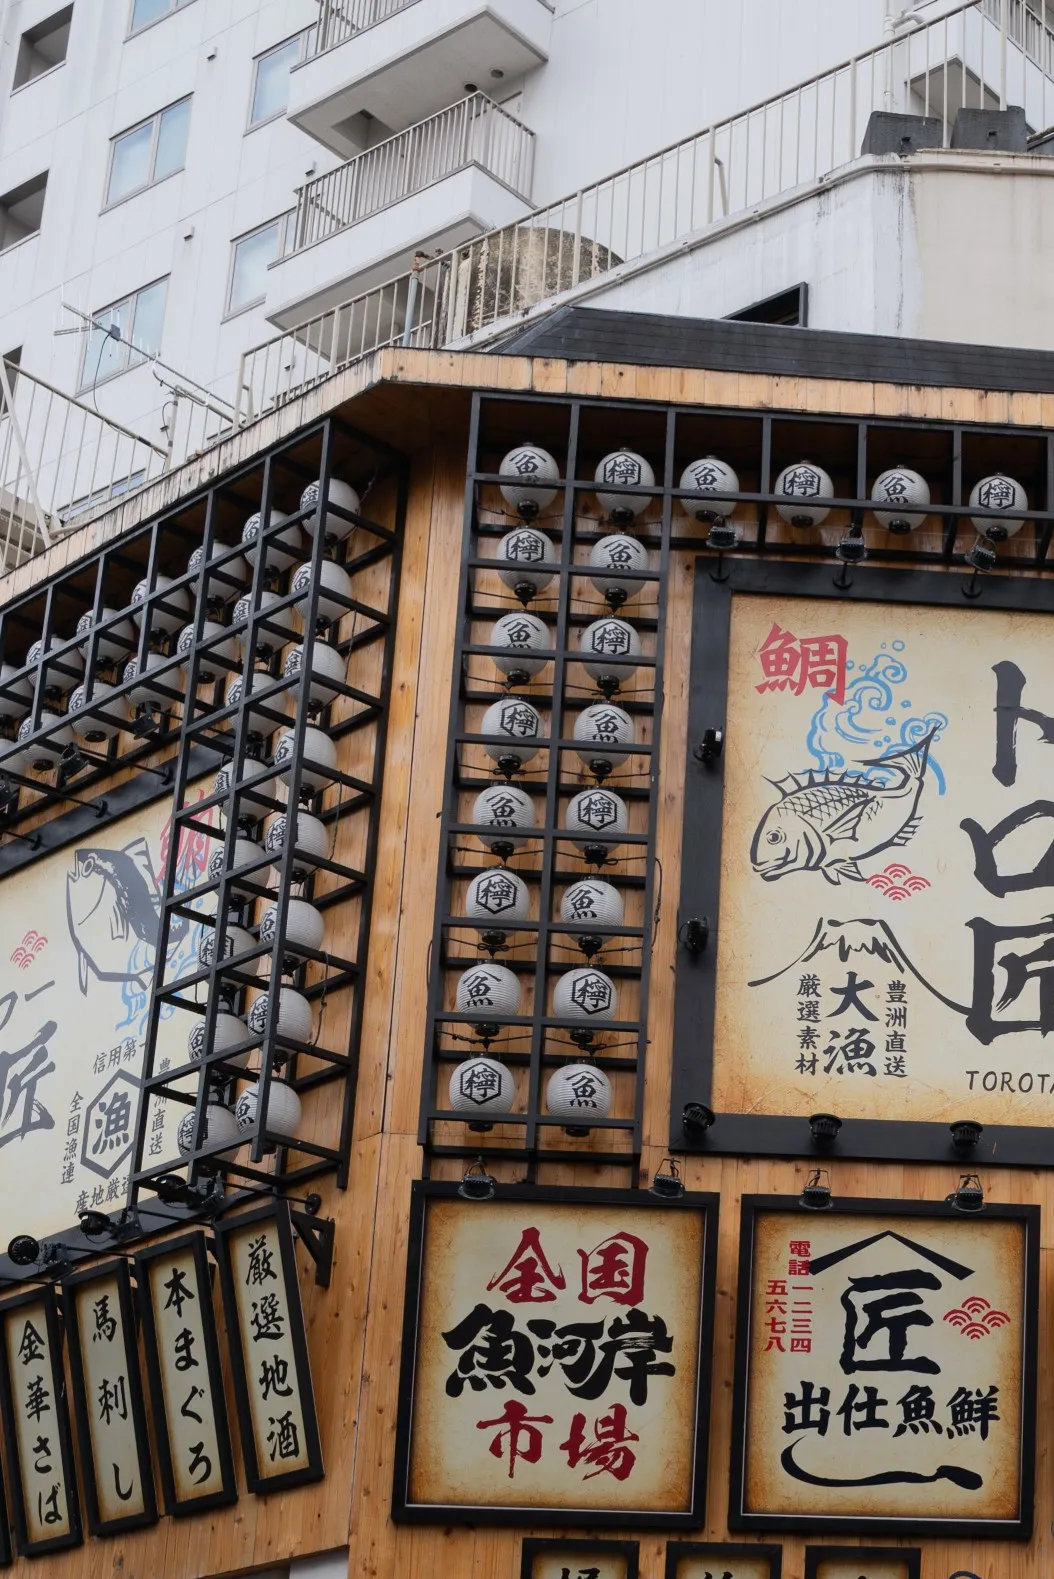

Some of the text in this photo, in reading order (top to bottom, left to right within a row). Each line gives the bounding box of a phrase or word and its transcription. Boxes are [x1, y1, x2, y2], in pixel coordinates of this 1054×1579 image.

[754, 623, 849, 706] 鯛
[795, 974, 822, 1076] 厳選素材
[823, 973, 879, 1077] 大漁
[883, 979, 909, 1078] 豊洲直送
[60, 1091, 84, 1184] 全国漁連
[486, 1227, 650, 1306] 全国
[245, 1234, 300, 1462] 厳選地酒
[442, 1303, 676, 1405] 魚河岸
[840, 1269, 943, 1375] 匠
[18, 1320, 64, 1527] 金華さば
[92, 1295, 134, 1501] 馬刺し
[164, 1268, 213, 1485] 本まぐろ
[476, 1399, 640, 1481] 市場
